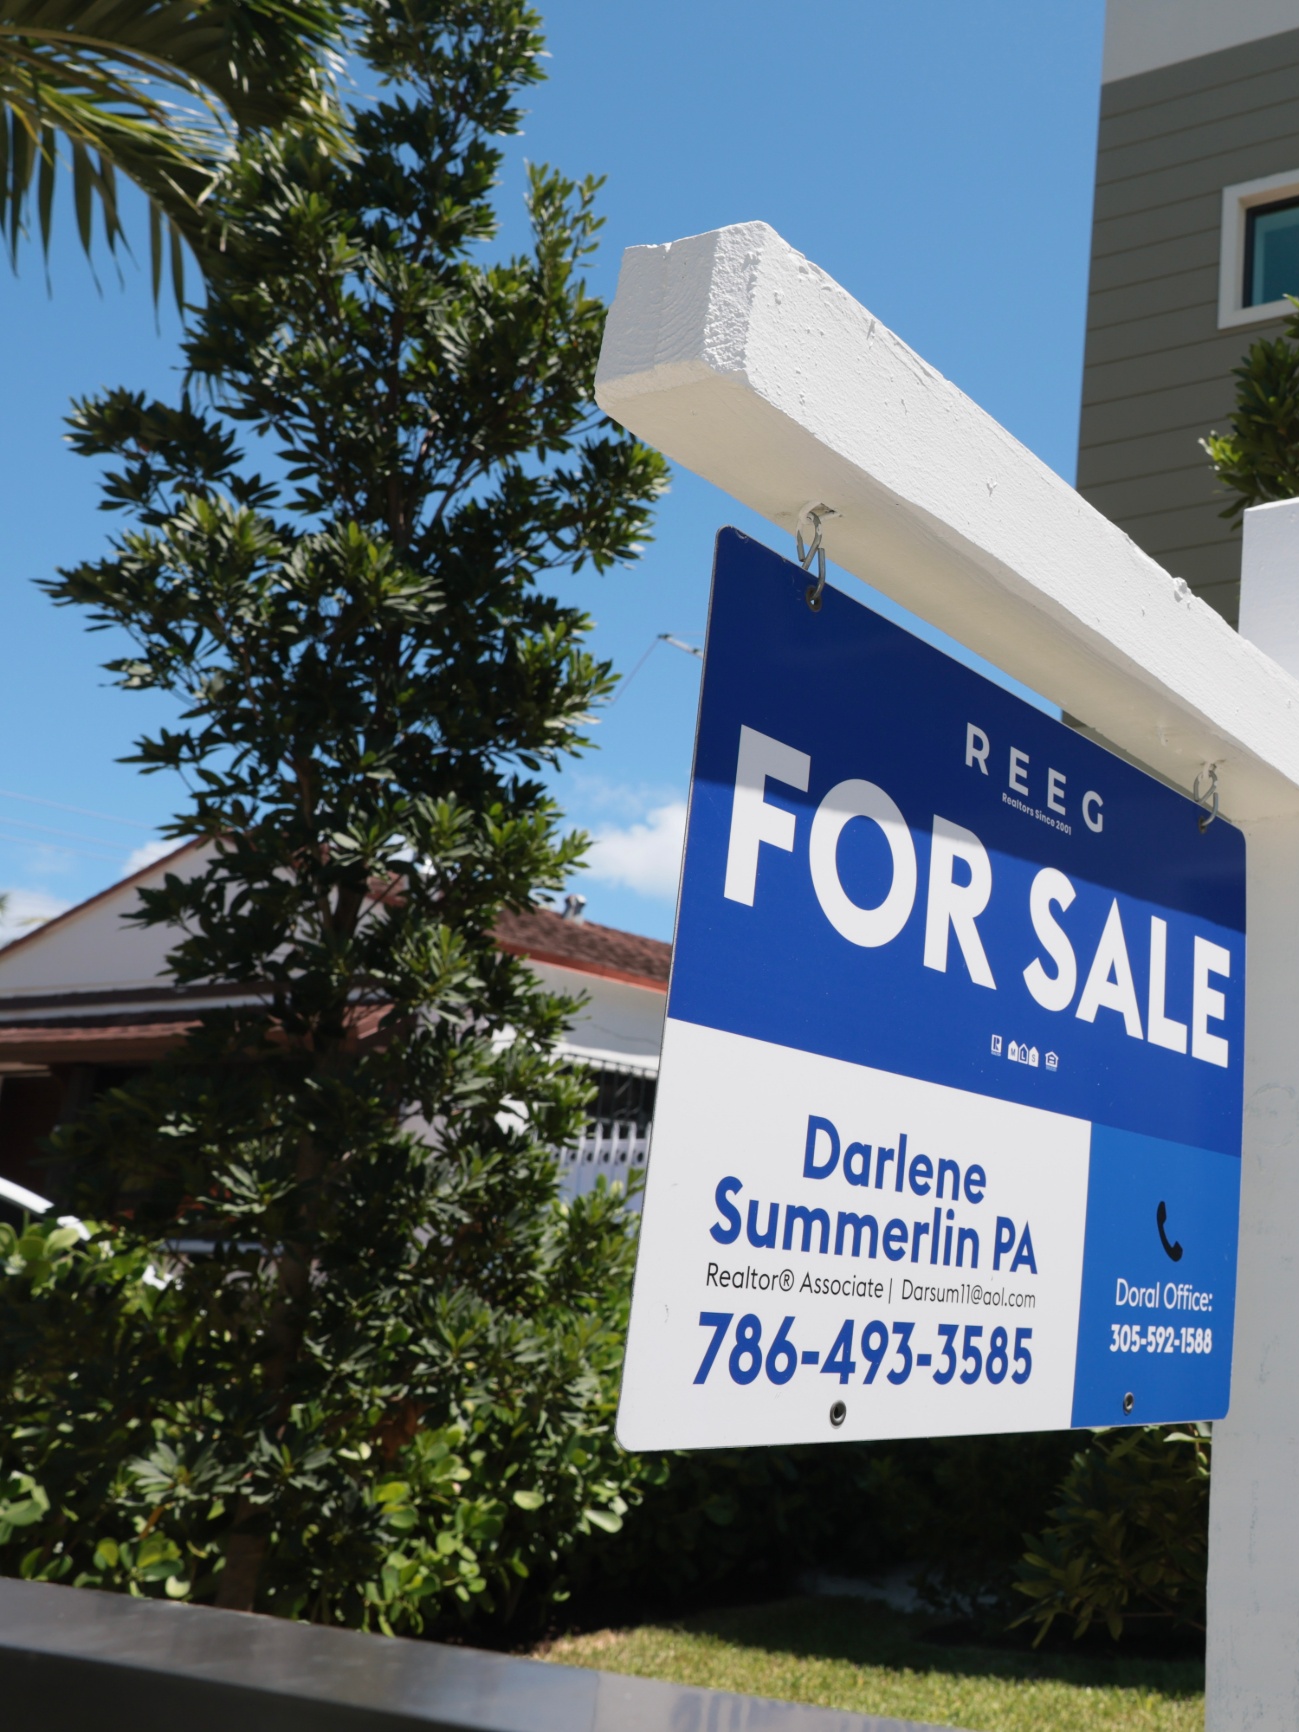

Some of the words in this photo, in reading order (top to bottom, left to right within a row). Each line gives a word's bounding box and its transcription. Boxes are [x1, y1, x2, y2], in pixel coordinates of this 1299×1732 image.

[965, 722, 1104, 833] REEG
[1002, 792, 1034, 817] Realtors
[1034, 809, 1056, 828] Since
[1055, 820, 1072, 836] 2001
[723, 724, 997, 991] FOR
[1023, 867, 1231, 1070] SALE
[803, 1114, 987, 1205] Darlene
[709, 1175, 981, 1270] Summerlin
[992, 1215, 1038, 1275] PA
[799, 1271, 884, 1299] Associate
[901, 1278, 1036, 1308] Darsum11@aol.com
[1115, 1278, 1160, 1309] Doral
[1163, 1282, 1213, 1312] Office:
[692, 1311, 1034, 1386] 786-493-3585
[1109, 1323, 1213, 1355] 305-592-1588
